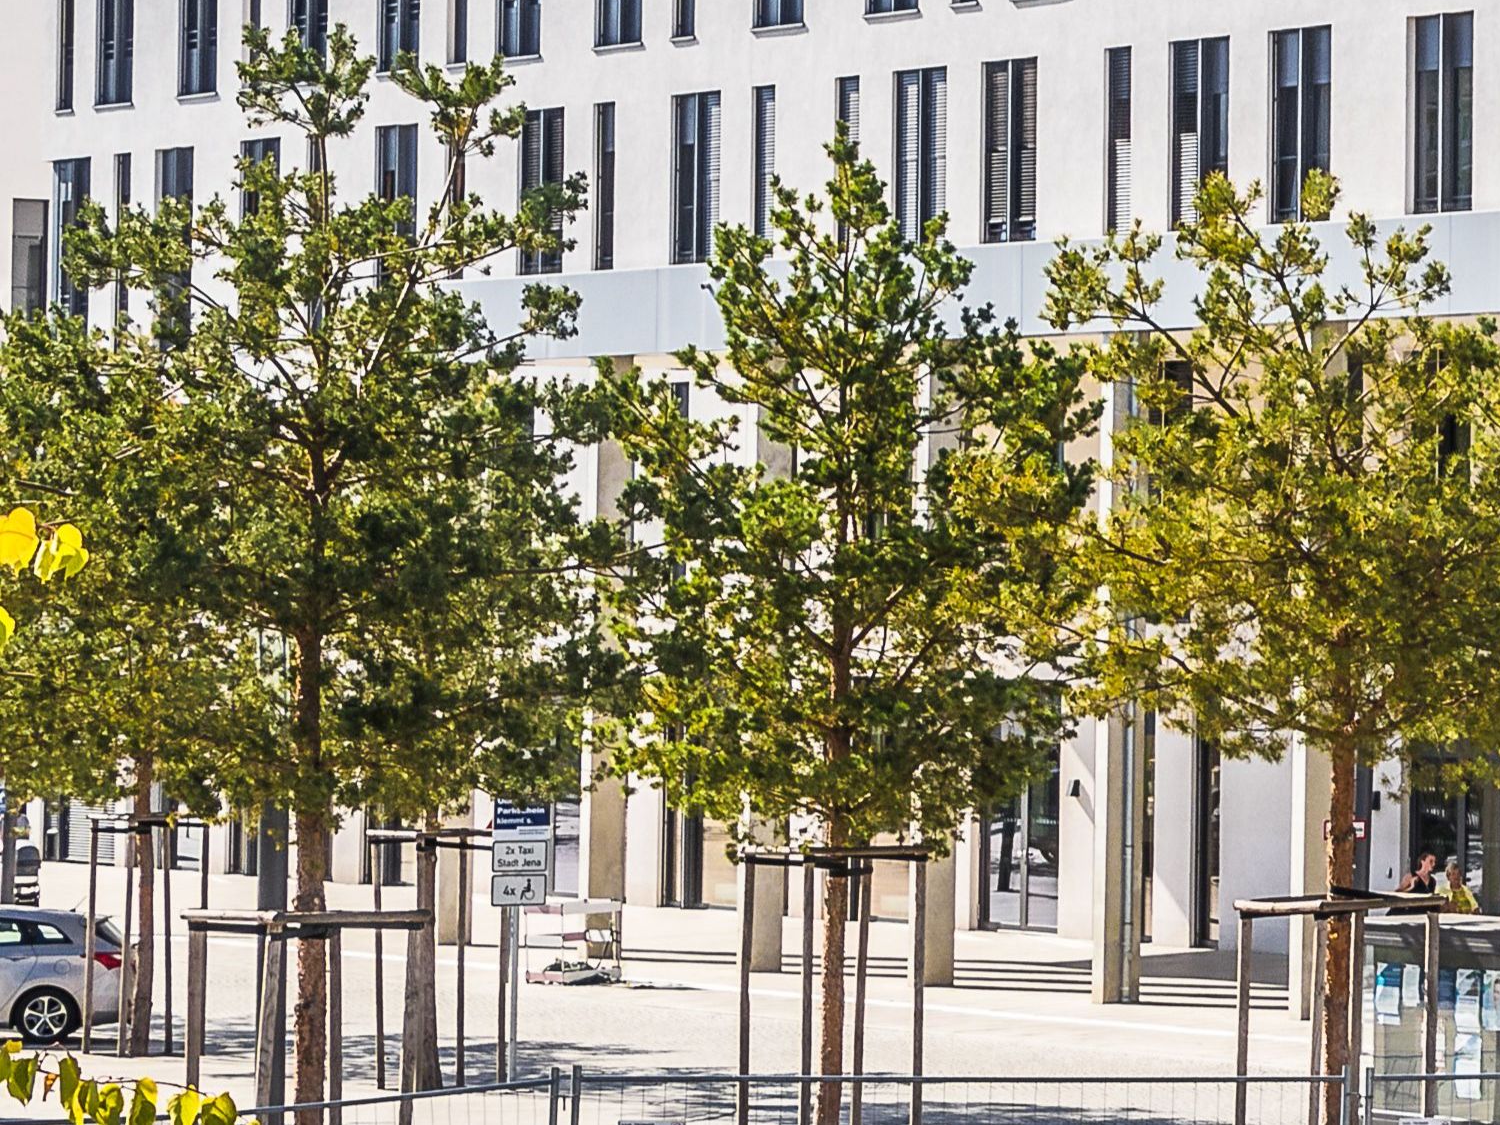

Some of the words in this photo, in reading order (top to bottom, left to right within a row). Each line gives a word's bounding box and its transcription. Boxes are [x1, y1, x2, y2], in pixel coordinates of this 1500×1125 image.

[505, 846, 515, 855] 2x
[518, 845, 535, 855] Taxi
[497, 858, 519, 867] Stadt
[521, 858, 542, 867] Jena
[503, 885, 517, 896] 4x
